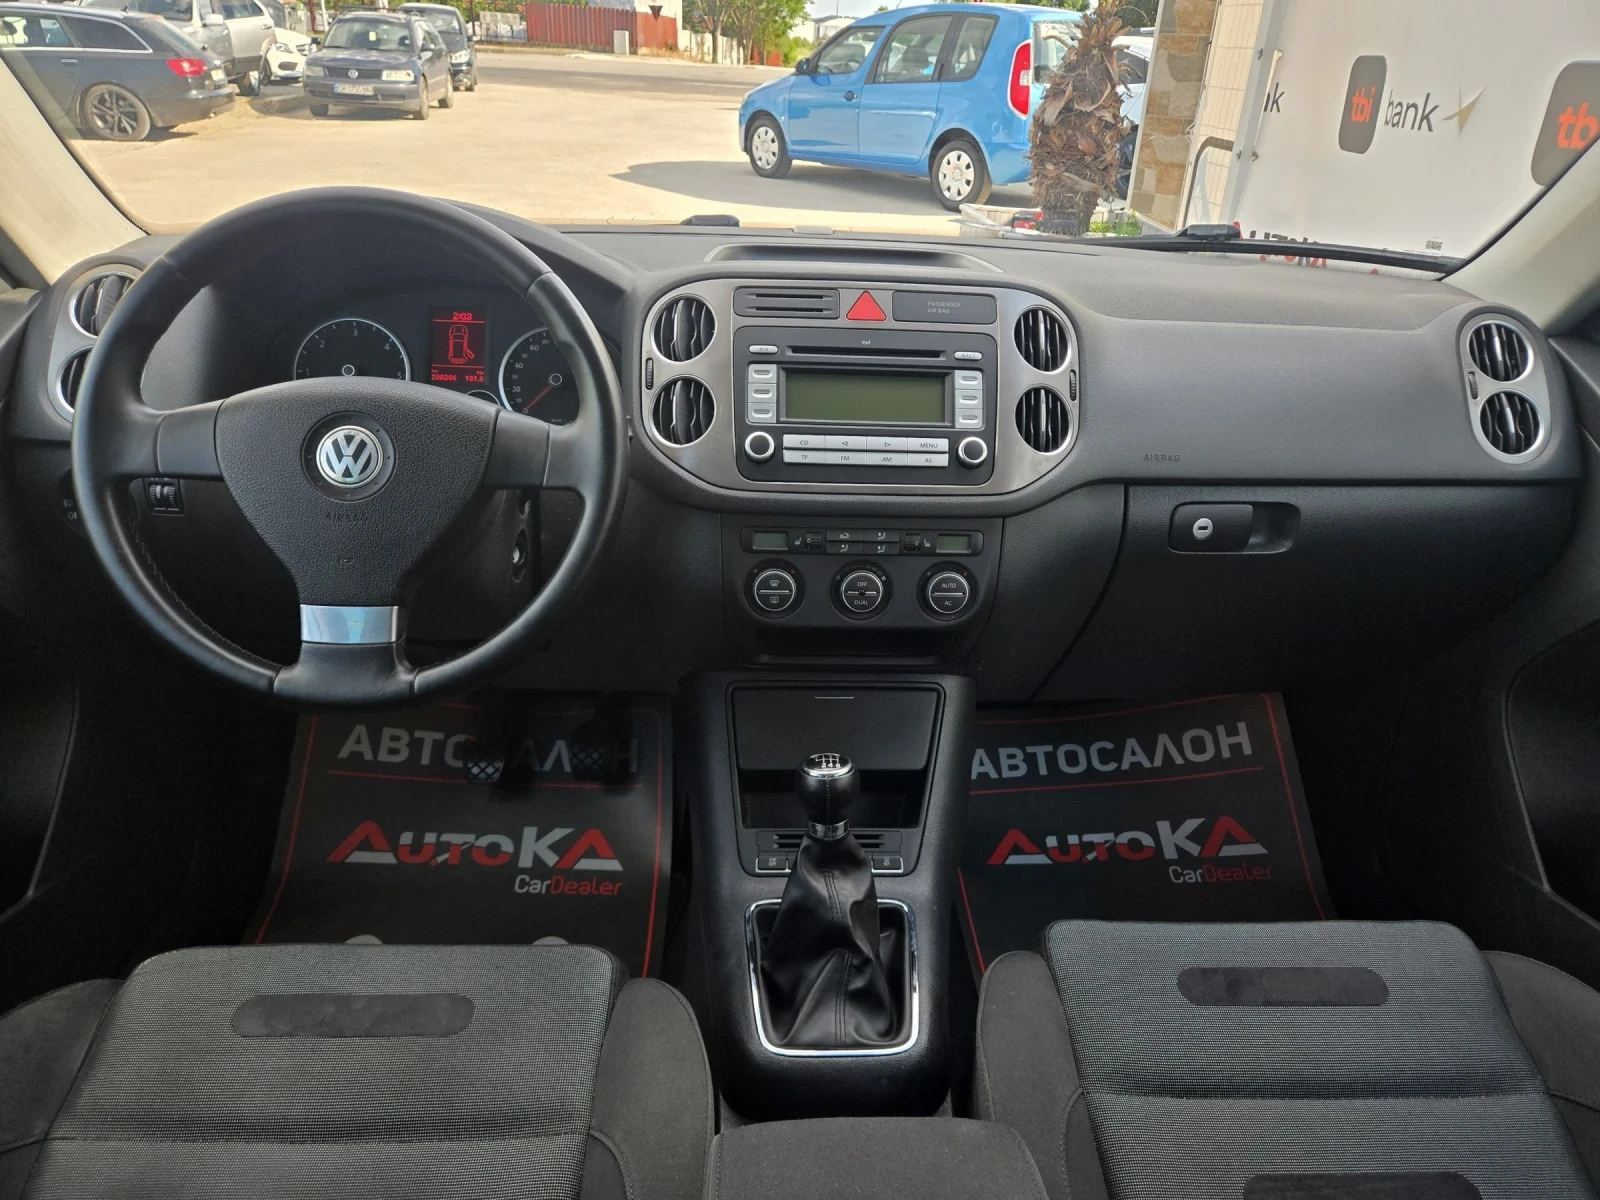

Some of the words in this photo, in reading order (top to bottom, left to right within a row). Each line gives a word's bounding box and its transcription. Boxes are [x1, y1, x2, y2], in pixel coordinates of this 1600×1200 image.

[1351, 86, 1376, 123] tbi
[1384, 89, 1440, 132] bank
[453, 312, 473, 320] 2:03
[352, 328, 358, 337] 3
[319, 340, 325, 348] 2
[384, 343, 390, 351] 4
[512, 385, 521, 393] 20
[1143, 454, 1180, 462] AIRBAG
[970, 721, 1253, 780] АВТОСАЛОН
[1168, 864, 1273, 884] CarDealer
[514, 874, 623, 896] CarDealer
